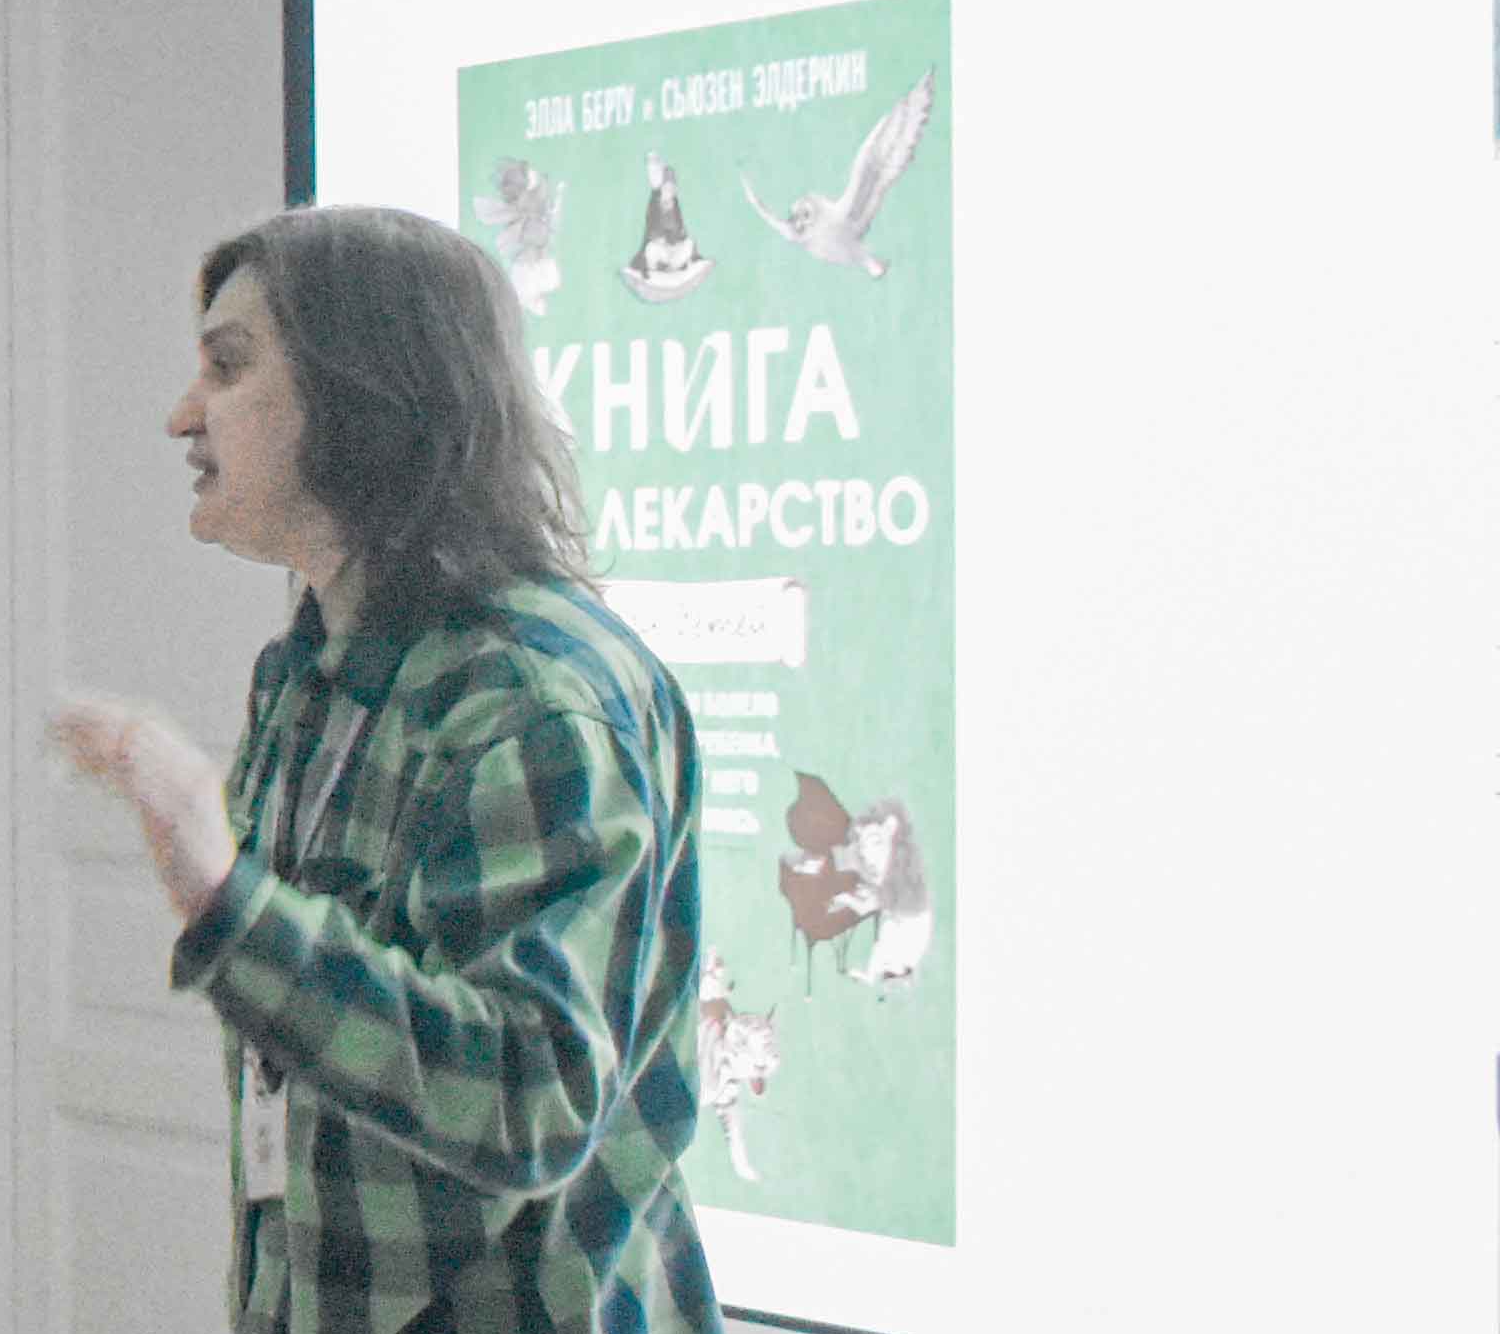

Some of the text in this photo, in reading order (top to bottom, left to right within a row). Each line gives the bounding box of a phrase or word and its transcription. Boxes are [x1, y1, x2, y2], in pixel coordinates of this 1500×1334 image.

[524, 94, 575, 139] ЭЛЛА
[582, 83, 636, 133] БЕРТУ
[752, 50, 868, 114] ЭЛДЕРКИН
[594, 476, 930, 551] ЛЕКАРСТВО
